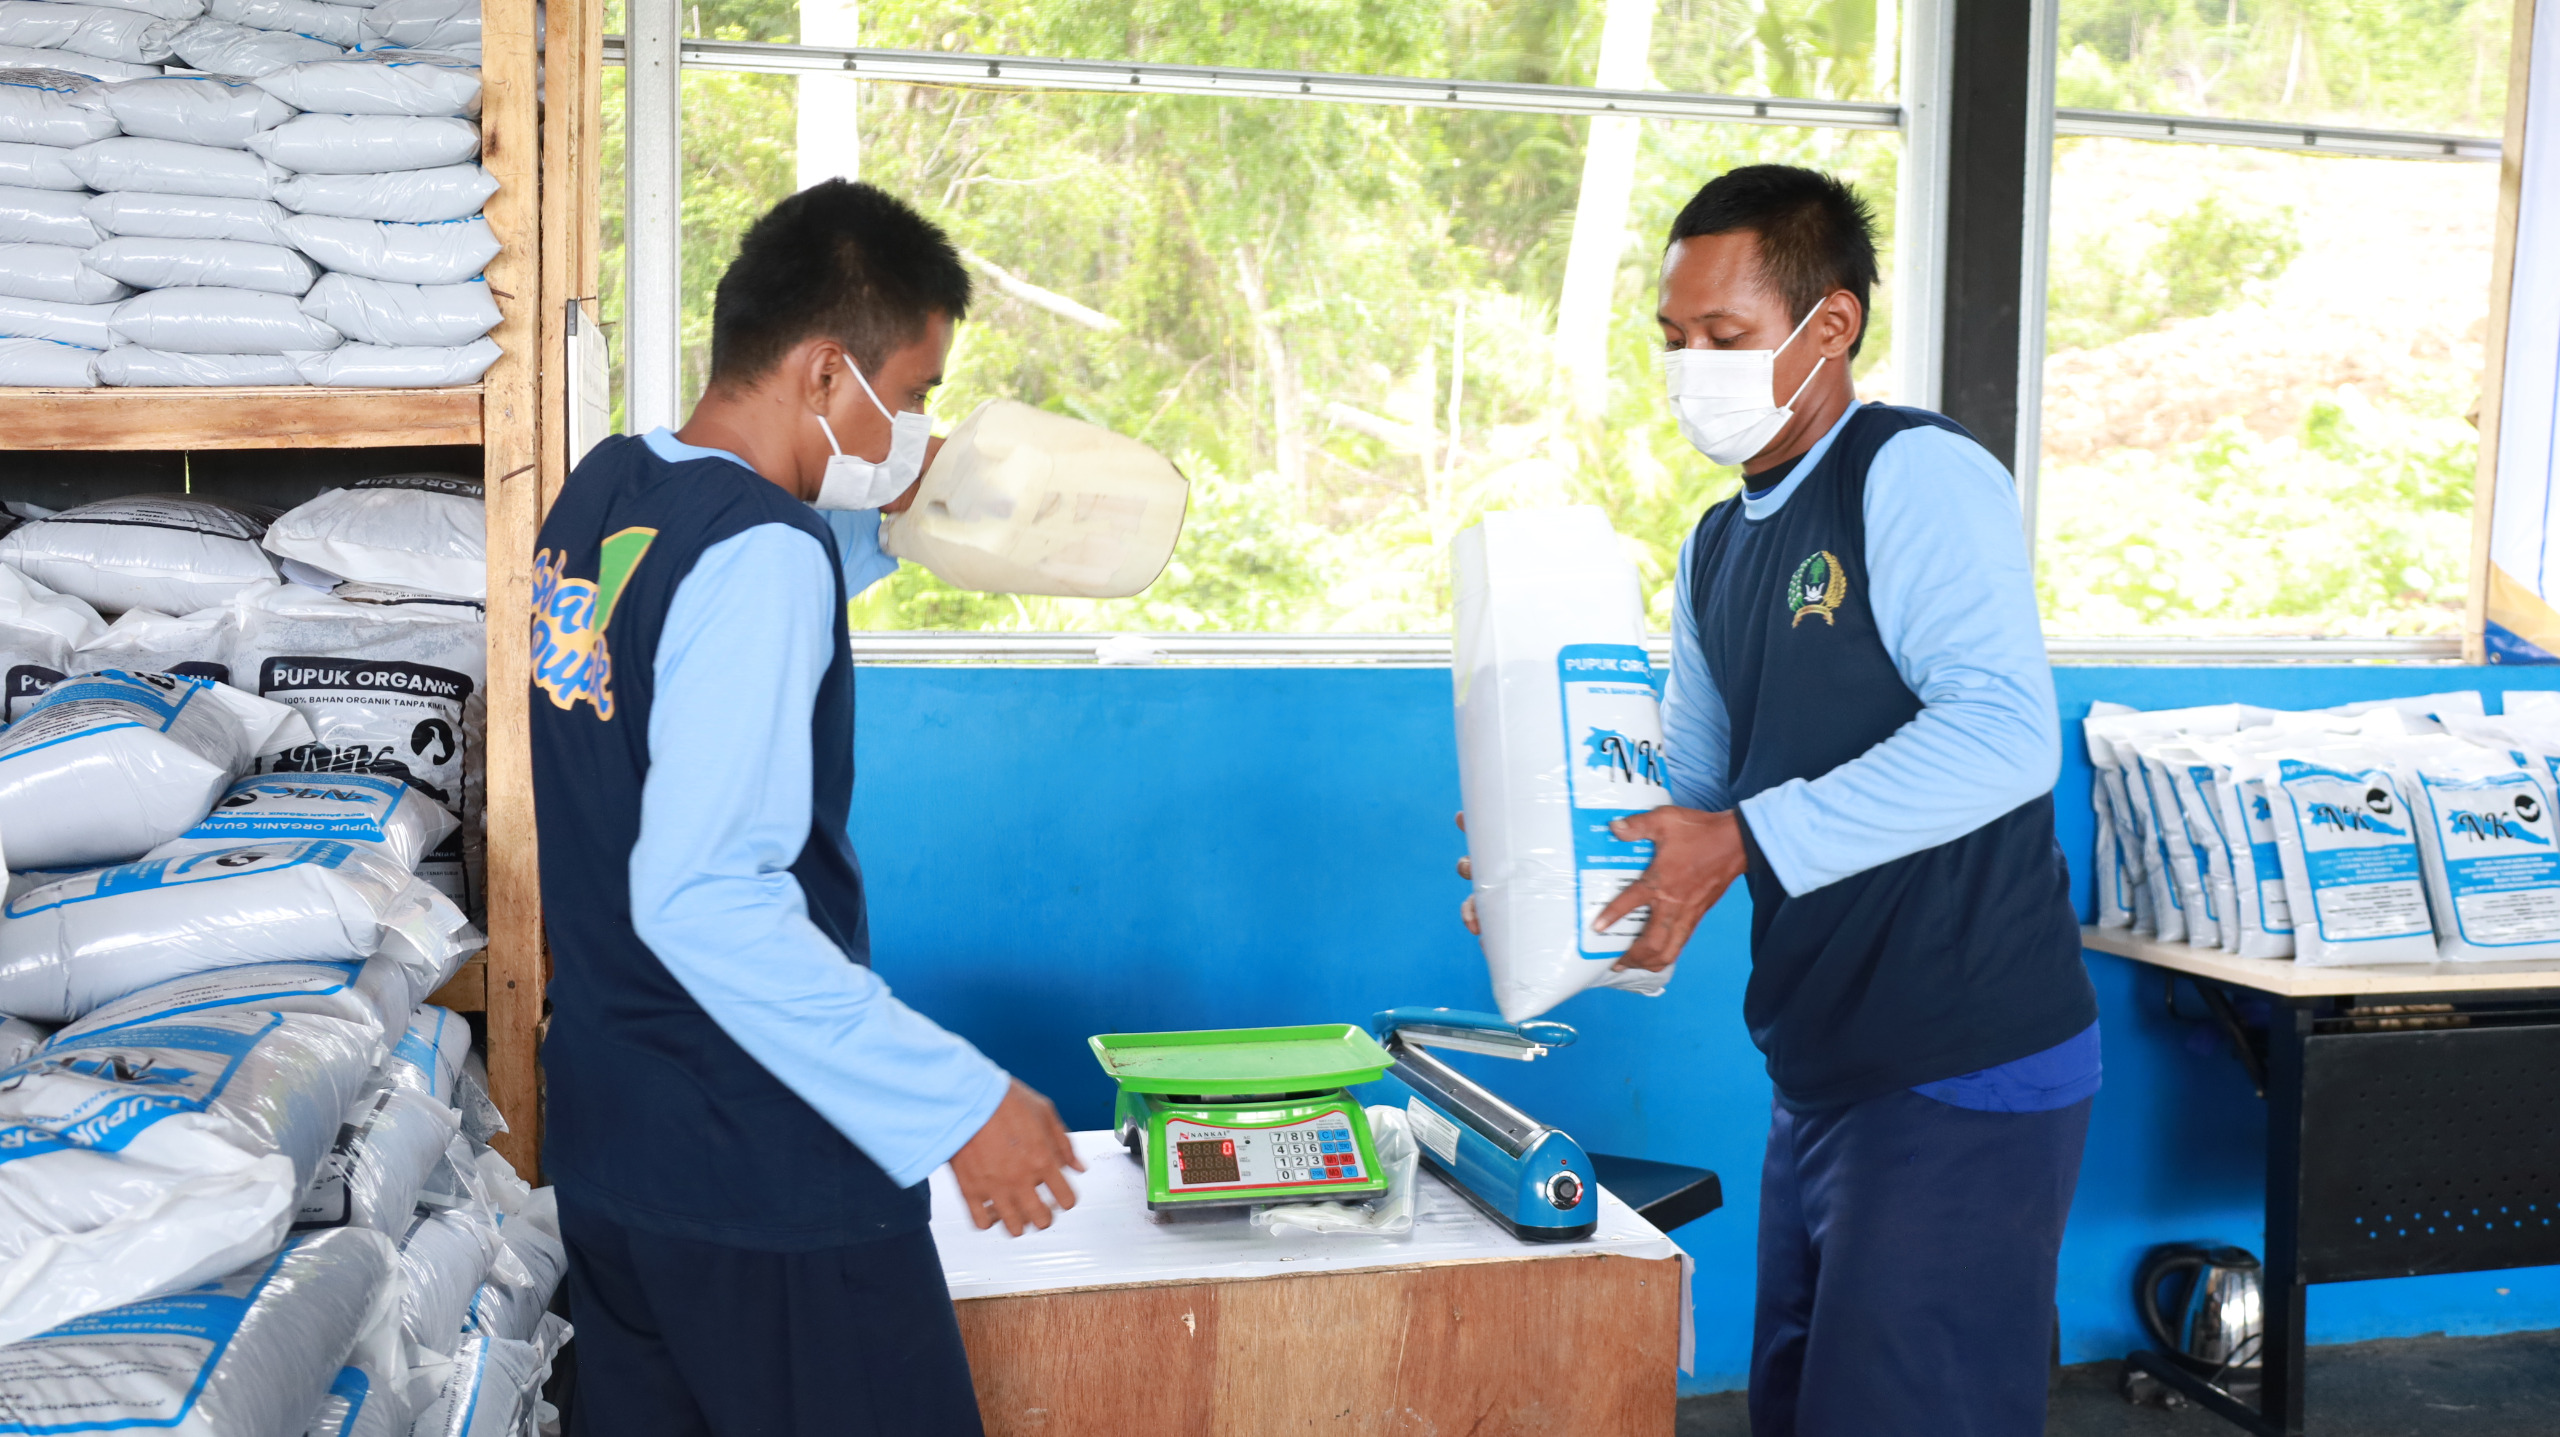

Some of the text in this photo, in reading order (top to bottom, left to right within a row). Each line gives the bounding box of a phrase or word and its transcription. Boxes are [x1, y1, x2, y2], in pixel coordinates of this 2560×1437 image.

[355, 477, 458, 490] ORGANIK
[1565, 658, 1619, 671] PUPUK
[273, 668, 459, 695] PUPUK ORGANIK
[284, 696, 307, 705] 100%
[309, 696, 344, 704] BAHAN
[346, 696, 391, 705] ORGANIK
[394, 699, 426, 709] TANPA
[2317, 805, 2371, 833] NK
[253, 822, 325, 831] ORGANIK
[330, 823, 381, 833] PUPUK
[2458, 811, 2514, 843] NK
[1190, 1130, 1227, 1138] NANKAI
[1274, 1133, 1281, 1142] 7
[1291, 1132, 1299, 1141] 8
[1306, 1131, 1315, 1140] 9
[1321, 1131, 1330, 1139] C
[1222, 1141, 1233, 1156] 0
[1277, 1145, 1285, 1154] 4
[1293, 1144, 1301, 1153] 5
[1309, 1143, 1318, 1153] 6
[1280, 1158, 1287, 1167] 1
[1295, 1157, 1304, 1166] 2
[1312, 1156, 1320, 1165] 3
[1282, 1170, 1290, 1180] 0
